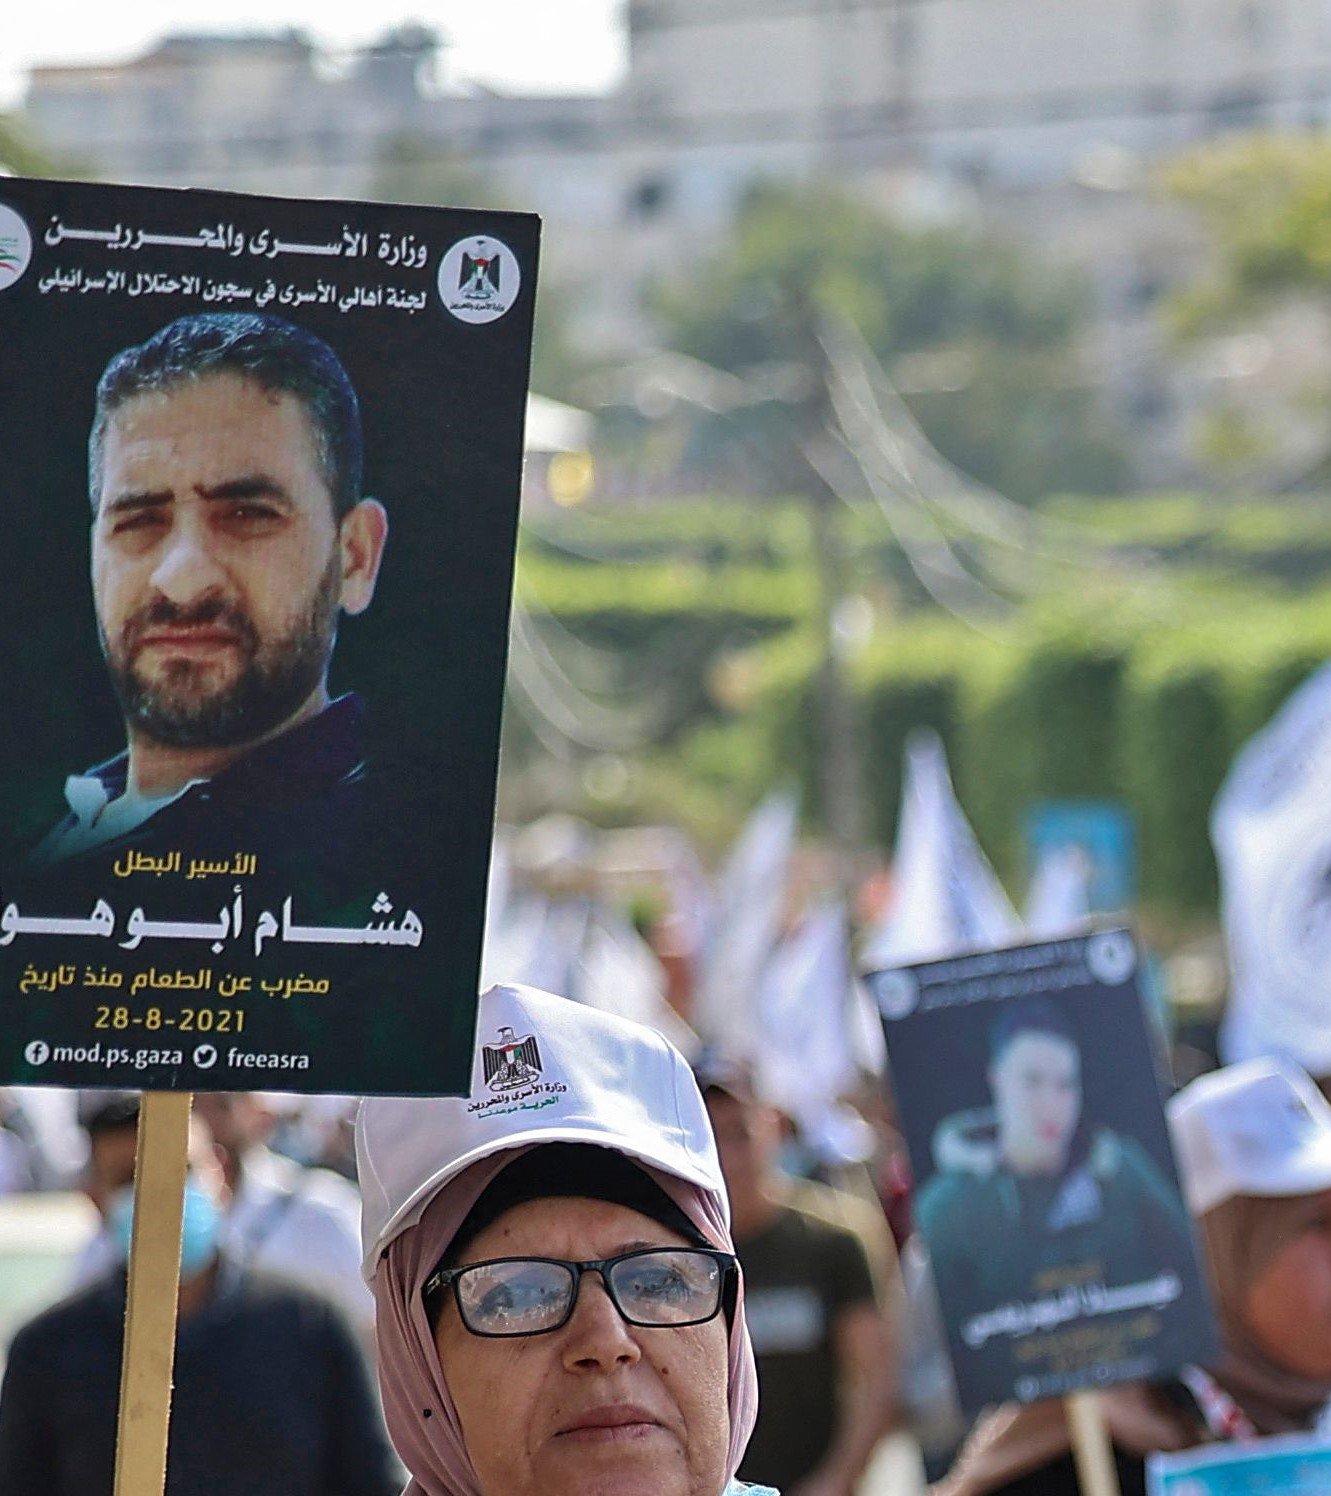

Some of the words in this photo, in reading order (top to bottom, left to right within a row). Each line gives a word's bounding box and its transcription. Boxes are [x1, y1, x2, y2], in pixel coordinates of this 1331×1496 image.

[44, 214, 245, 256] والمحررين
[249, 223, 368, 258] الأسرى
[377, 232, 428, 269] وزارة
[127, 272, 200, 296] الاحتلال
[203, 279, 252, 301] سجون
[254, 278, 276, 307] في
[278, 279, 336, 306] الأسرى
[338, 283, 382, 312] أهالي
[386, 288, 427, 314] لجنة
[114, 850, 180, 878] البطل
[187, 853, 257, 880] الأسير
[118, 884, 243, 954] أبو
[254, 891, 424, 957] هشام
[19, 964, 75, 994] تاريخ
[83, 968, 122, 988] منذ
[130, 967, 211, 995] الطعام
[218, 973, 252, 997] عن
[259, 973, 330, 999] مضرب
[94, 1006, 246, 1033] 28-8-2021
[52, 1045, 183, 1070] mod.ps.gaza
[227, 1051, 310, 1070] freeasra
[545, 1081, 568, 1093] وزارة
